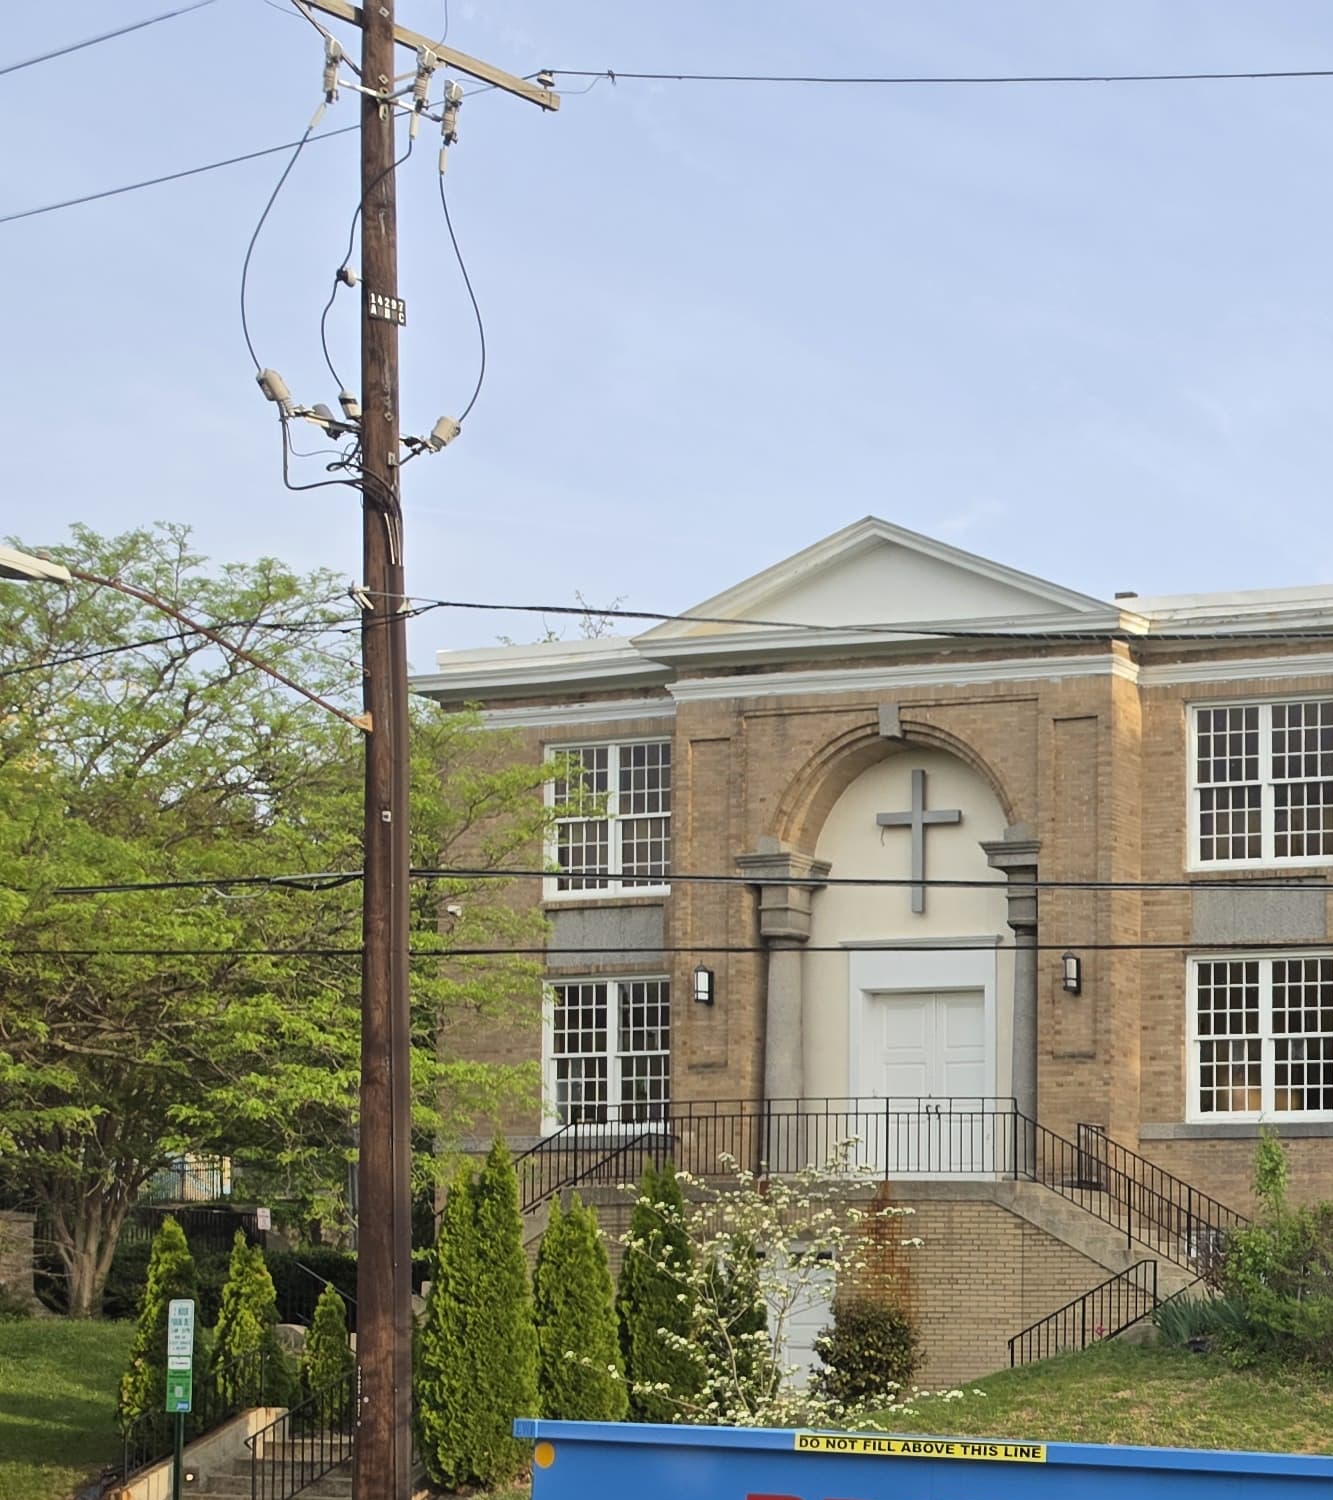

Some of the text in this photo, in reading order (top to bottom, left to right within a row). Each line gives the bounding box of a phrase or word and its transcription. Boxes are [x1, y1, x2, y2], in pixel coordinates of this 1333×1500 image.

[398, 312, 405, 323] C
[799, 1438, 1042, 1459] DO NOT FILL ABOVE THIS LINE
